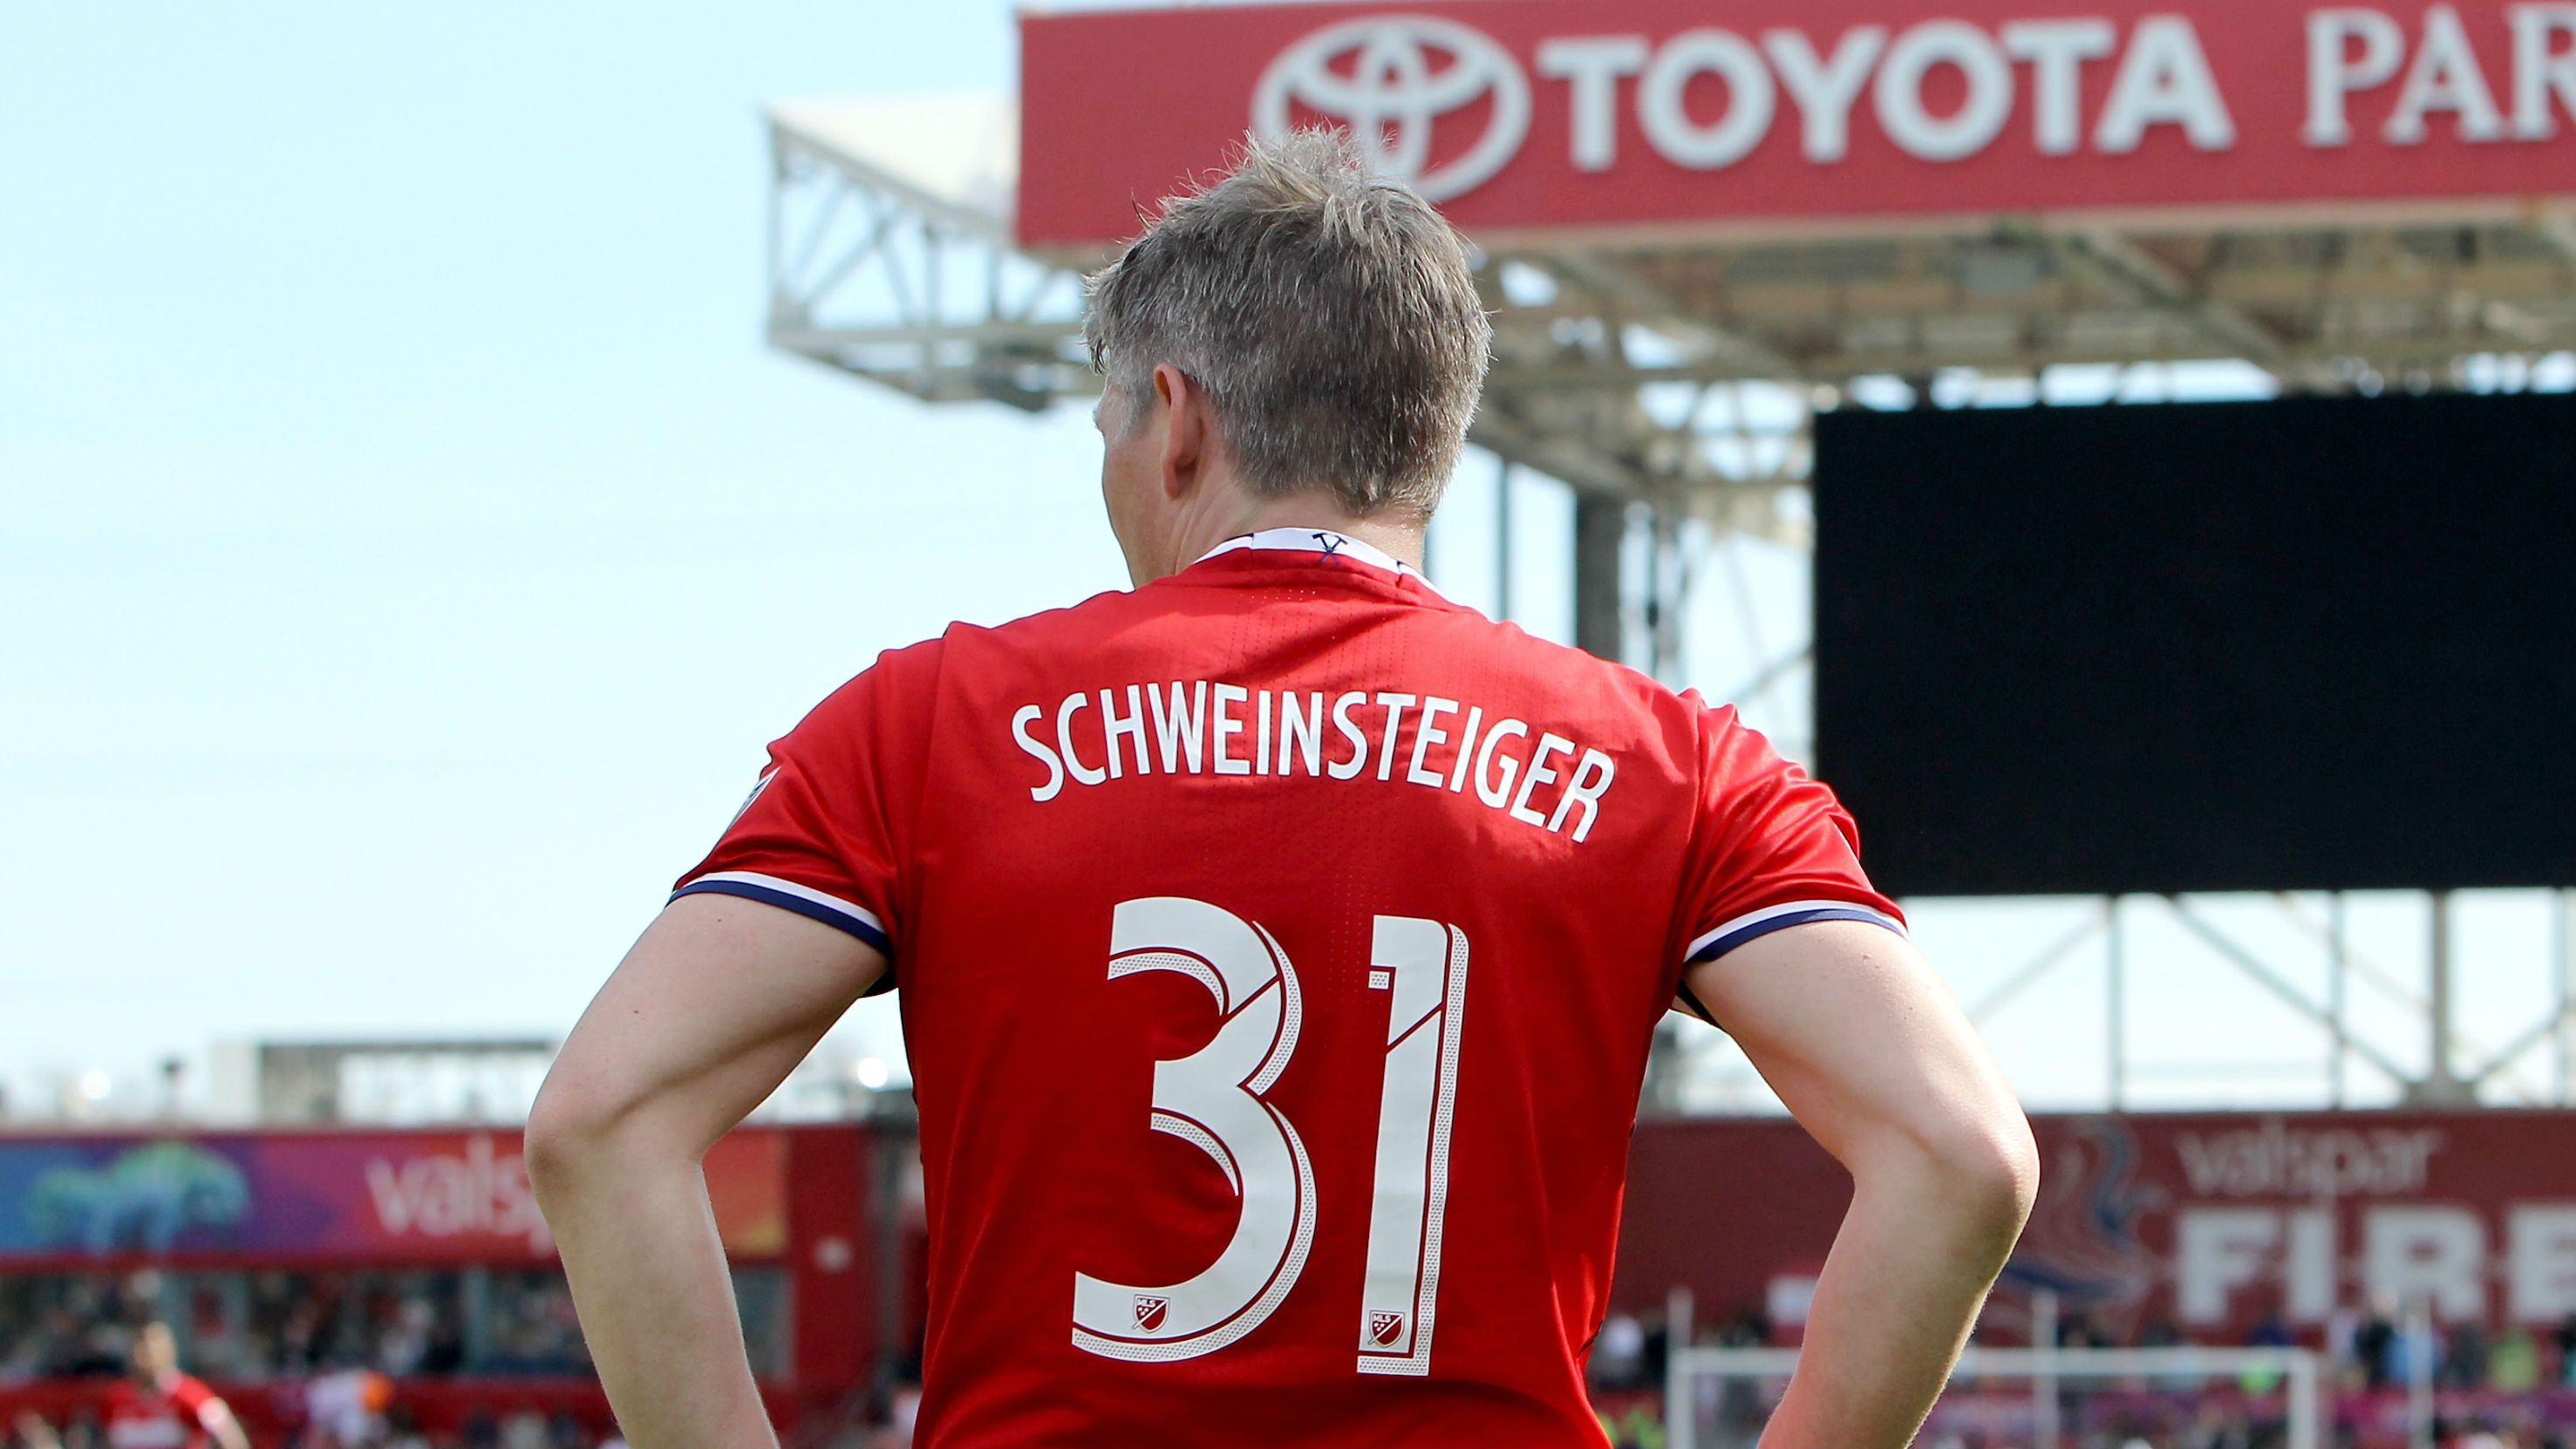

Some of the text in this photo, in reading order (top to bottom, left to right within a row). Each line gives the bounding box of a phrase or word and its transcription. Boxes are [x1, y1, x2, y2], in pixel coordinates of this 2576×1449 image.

[1536, 13, 2237, 173] TOYOTA
[1012, 680, 1615, 844] SCHWEINSTEIGER
[1071, 895, 1470, 1377] 31
[2173, 1112, 2441, 1210] valspar
[1137, 1298, 1156, 1308] MLS
[1373, 1314, 1392, 1323] MLS
